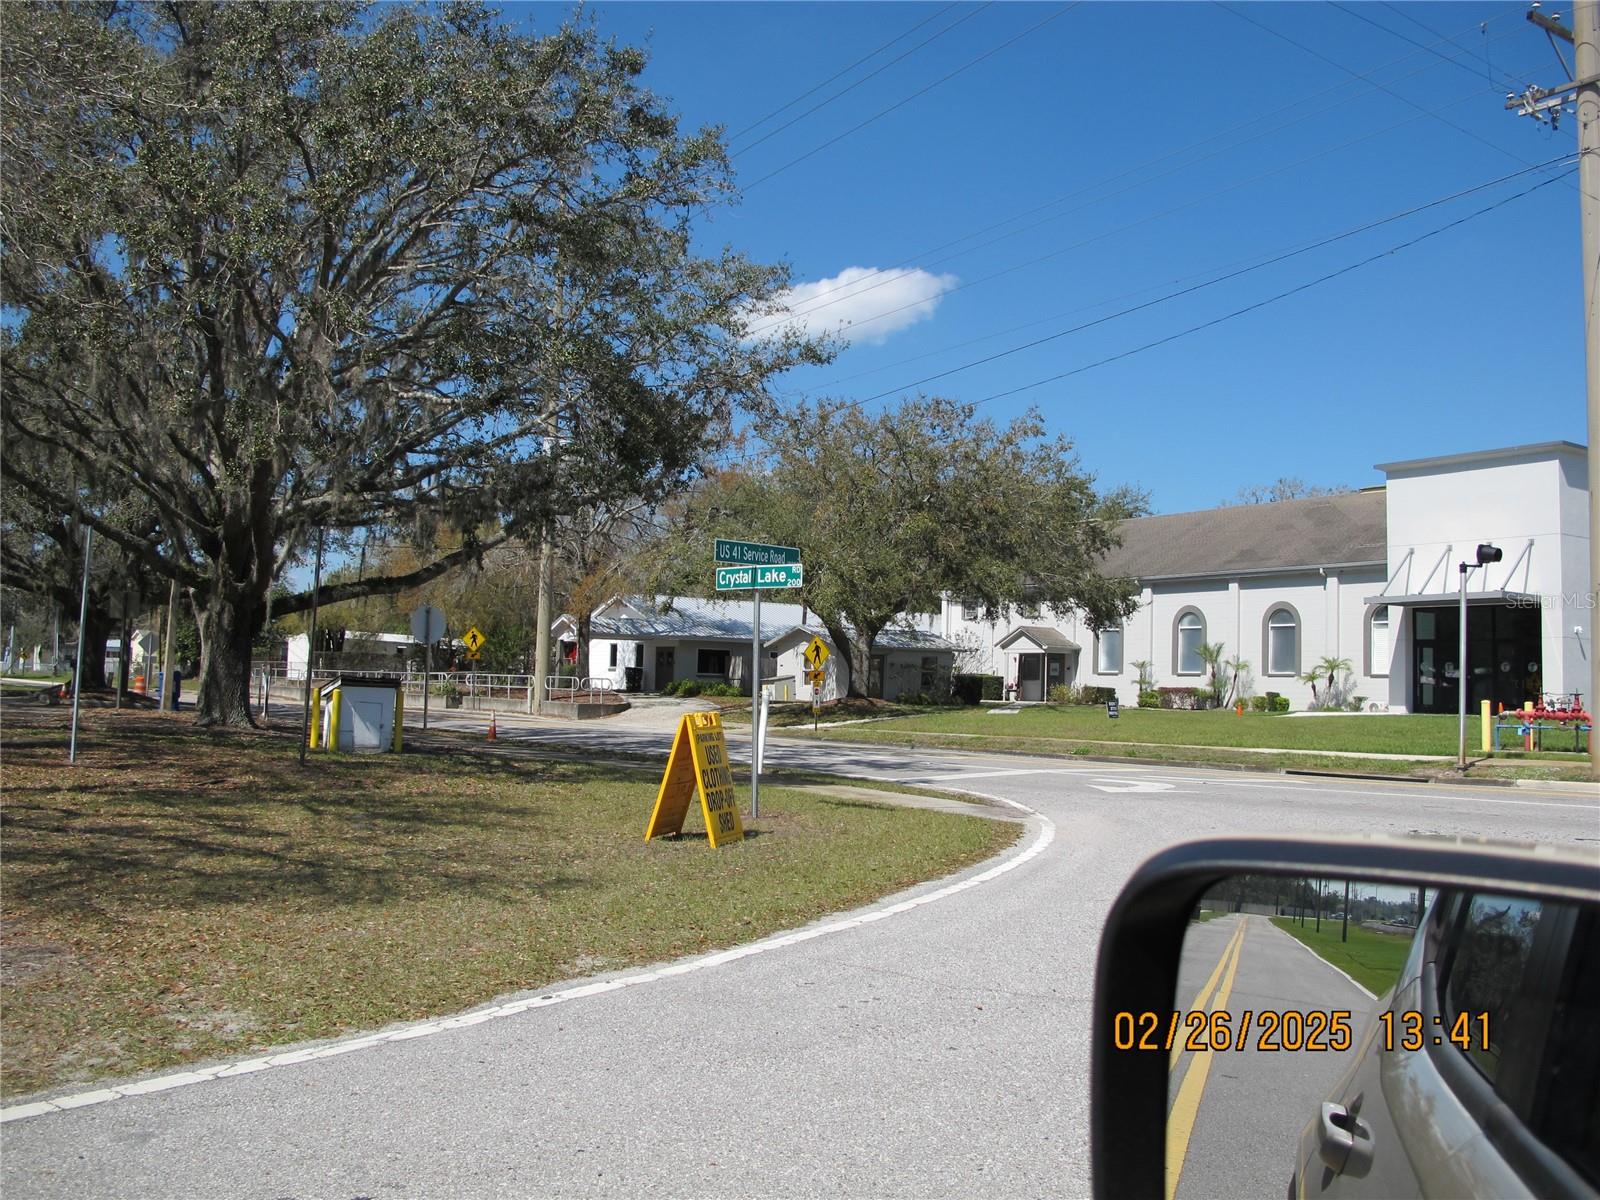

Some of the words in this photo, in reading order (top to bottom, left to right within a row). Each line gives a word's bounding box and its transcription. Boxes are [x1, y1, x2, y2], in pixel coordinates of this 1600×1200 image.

[719, 544, 731, 559] US
[732, 546, 741, 559] 41
[743, 547, 768, 562] Service
[769, 550, 786, 564] Road
[719, 570, 752, 587] Crystal
[757, 569, 787, 583] Lake
[792, 566, 801, 574] RD
[787, 578, 801, 587] 200
[705, 745, 722, 765] USED
